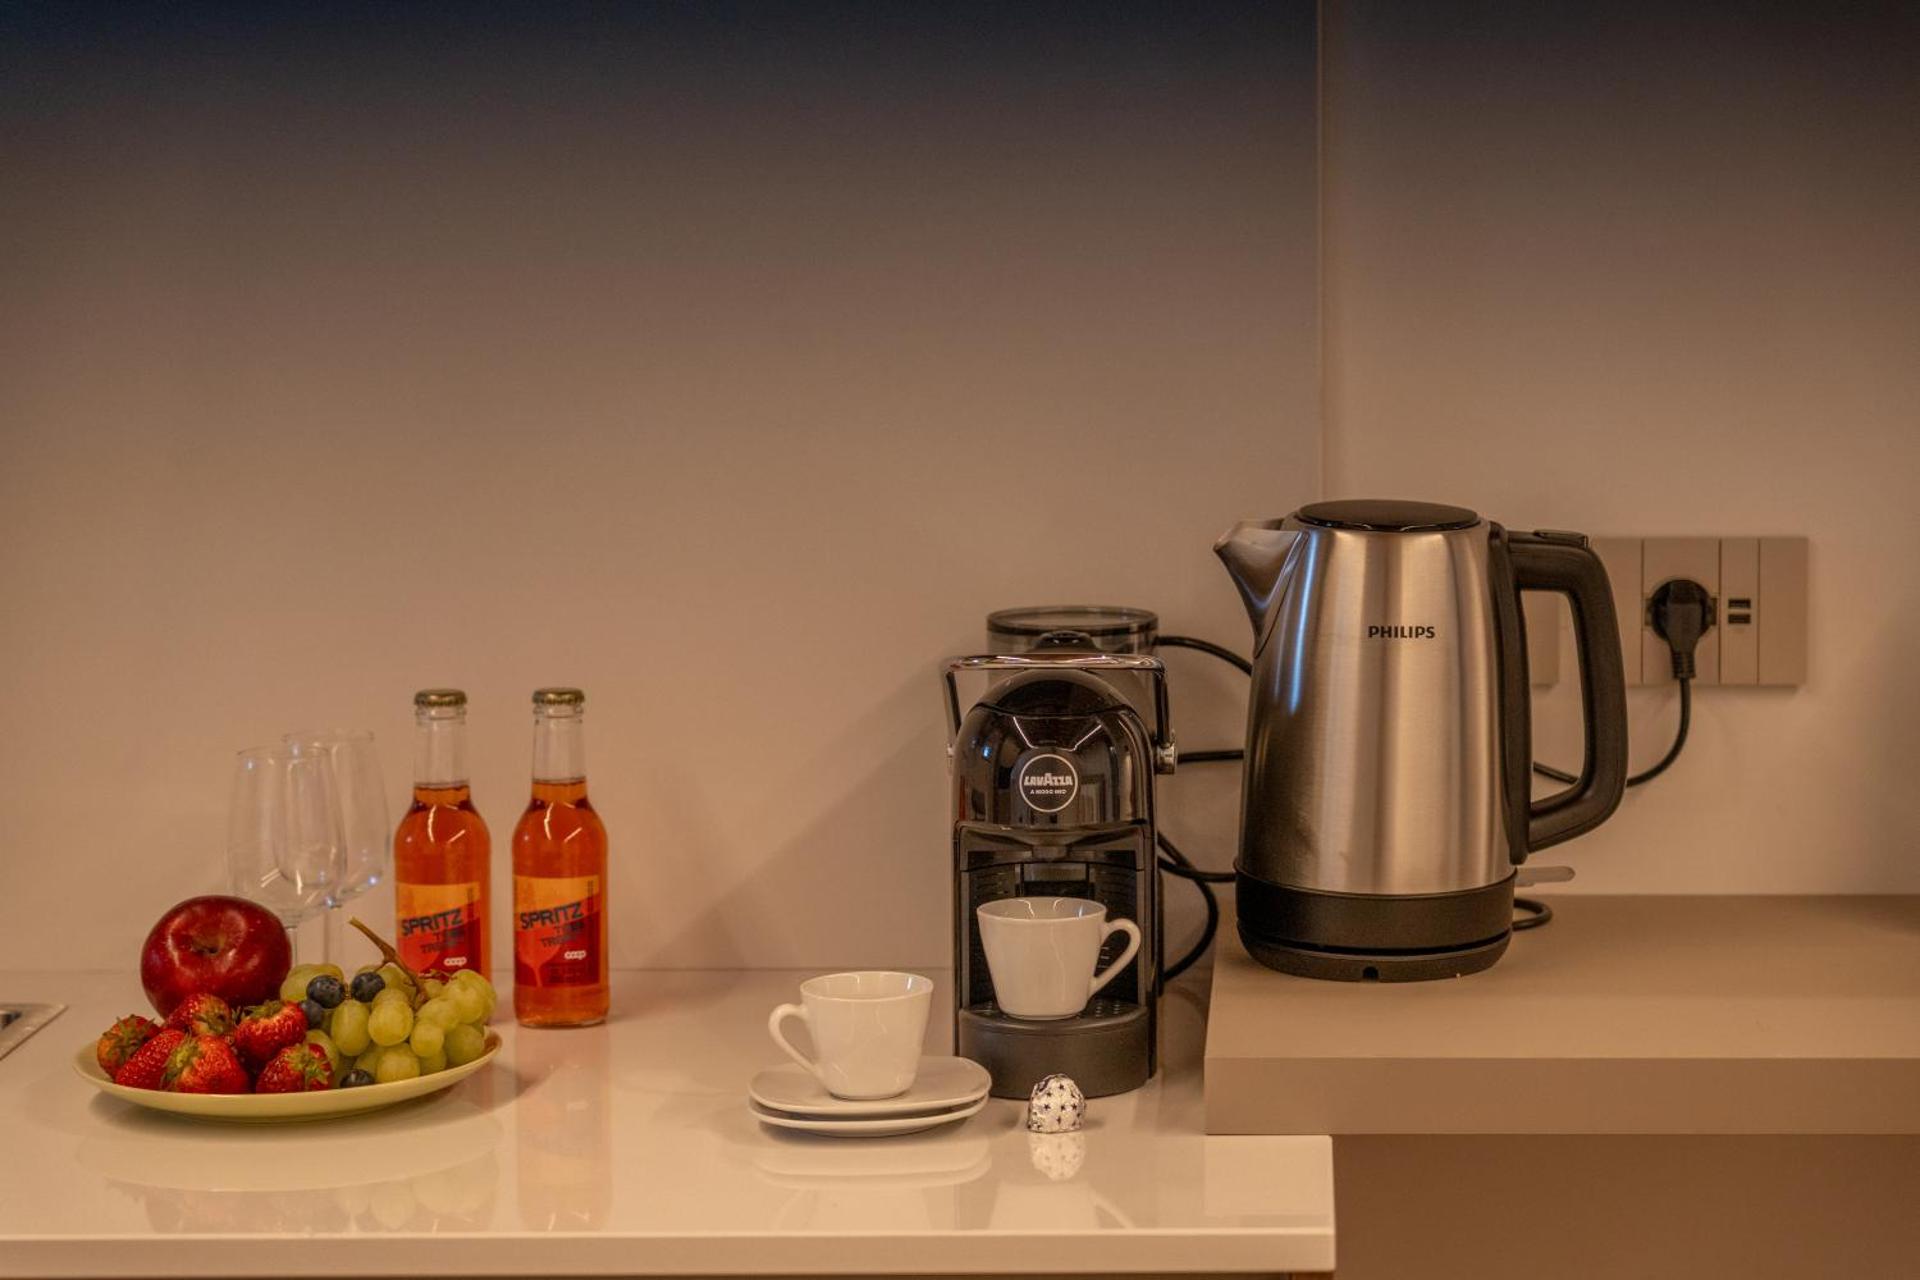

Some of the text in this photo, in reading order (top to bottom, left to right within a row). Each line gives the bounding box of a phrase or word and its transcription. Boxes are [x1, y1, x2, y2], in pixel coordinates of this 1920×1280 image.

[1368, 625, 1435, 639] PHILIPS
[1024, 773, 1073, 786] LAVAZZA
[401, 908, 463, 936] SPRITZ
[519, 902, 584, 930] SPRITZ
